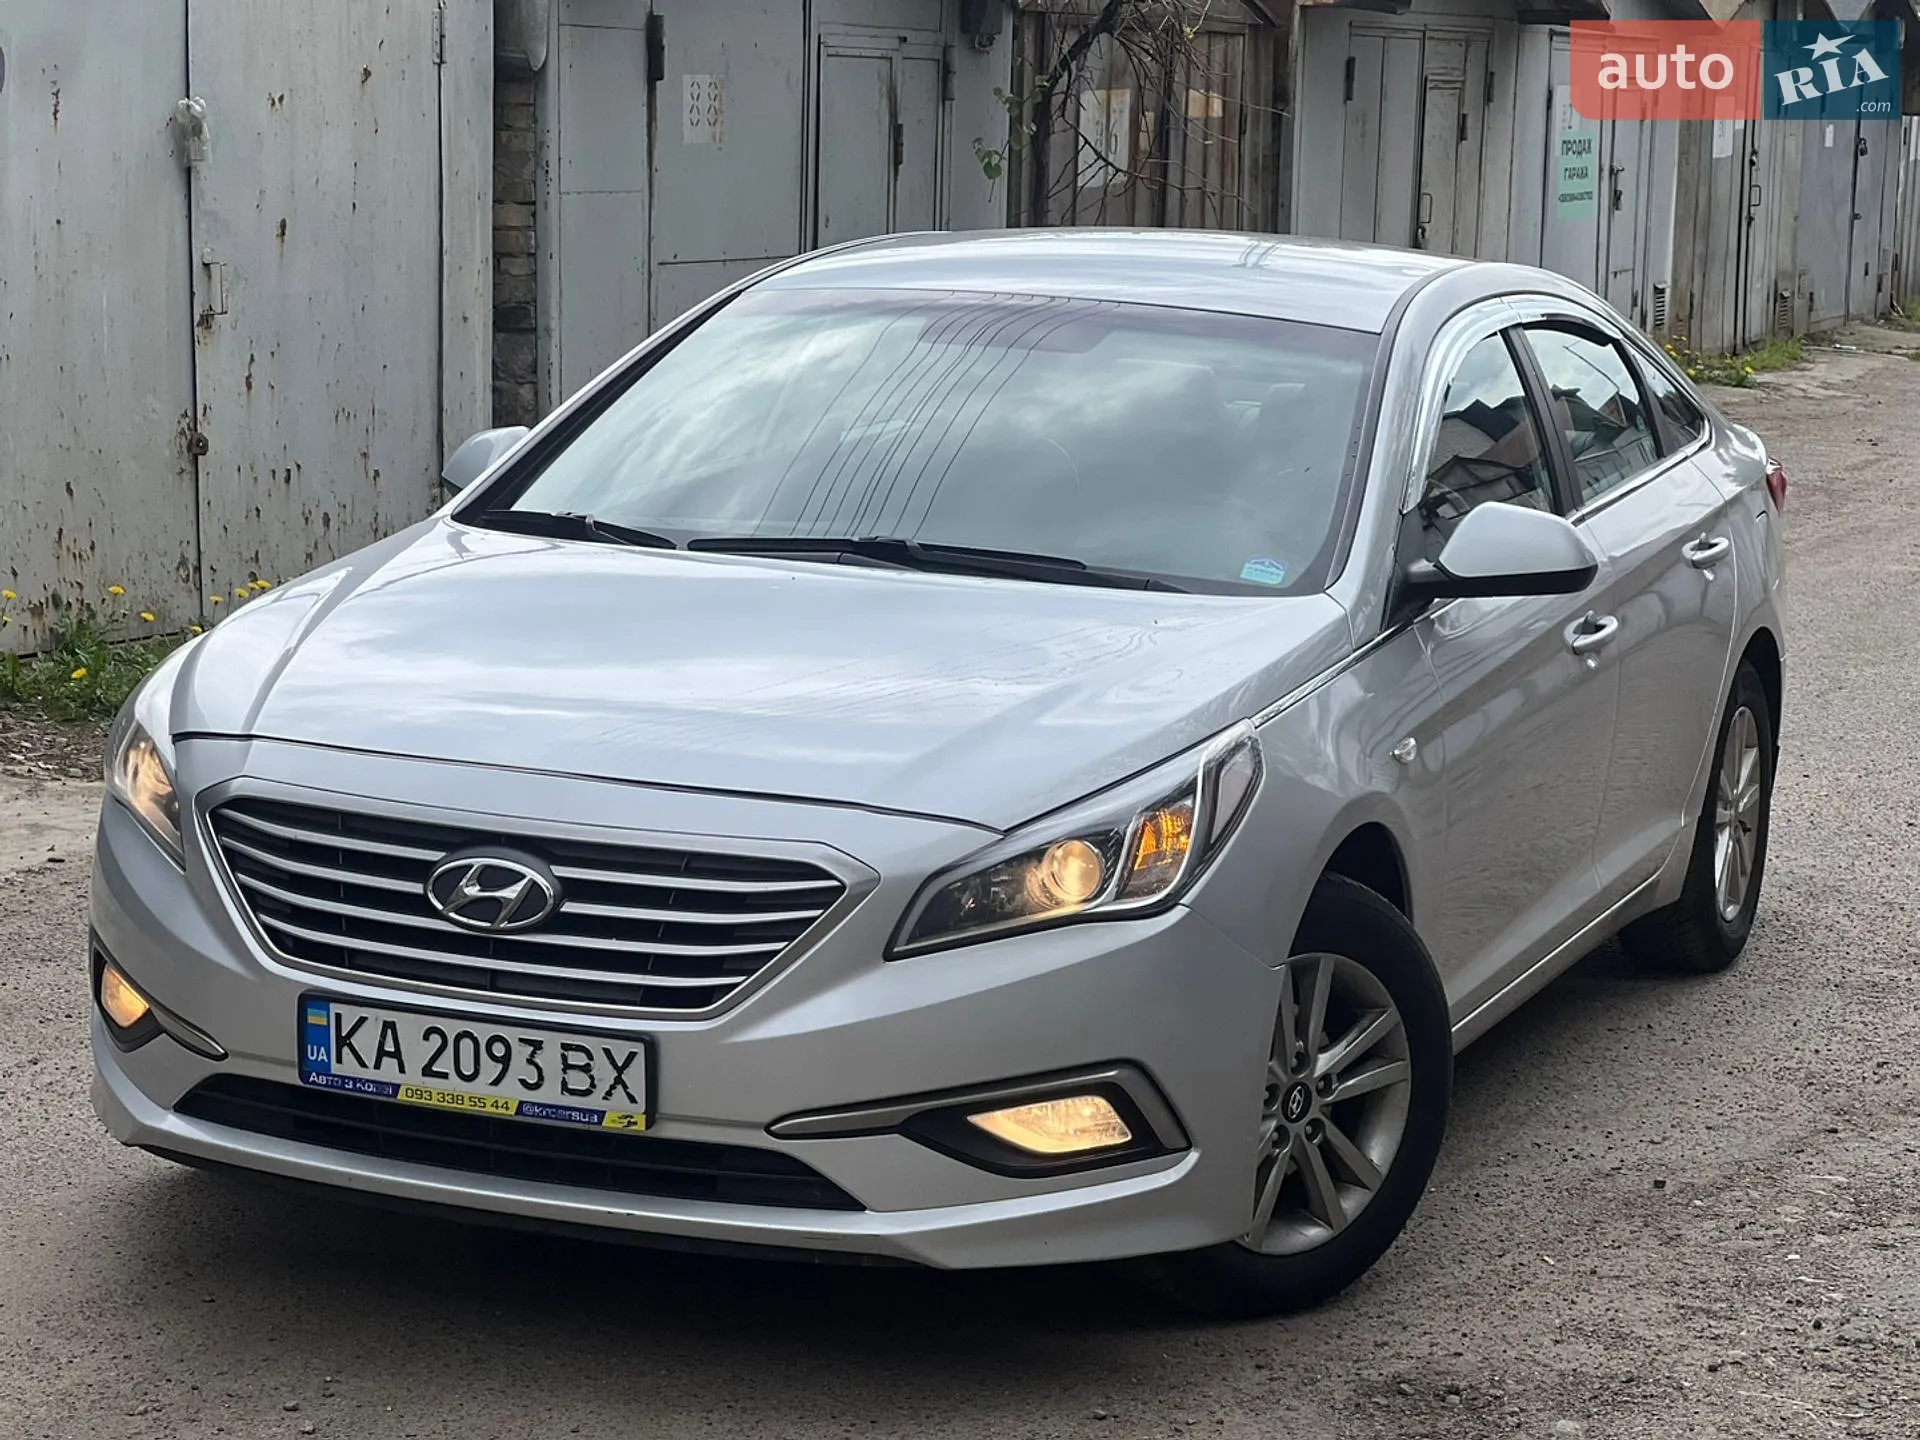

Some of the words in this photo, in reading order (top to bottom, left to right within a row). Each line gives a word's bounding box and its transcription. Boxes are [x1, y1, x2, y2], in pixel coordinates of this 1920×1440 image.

[1561, 139, 1592, 158] ПРОДАЖ
[307, 1045, 328, 1062] UA
[421, 1026, 545, 1091] 2093
[405, 1087, 432, 1101] 093
[436, 1091, 464, 1105] 338
[469, 1095, 486, 1108] 55
[490, 1099, 510, 1111] 44
